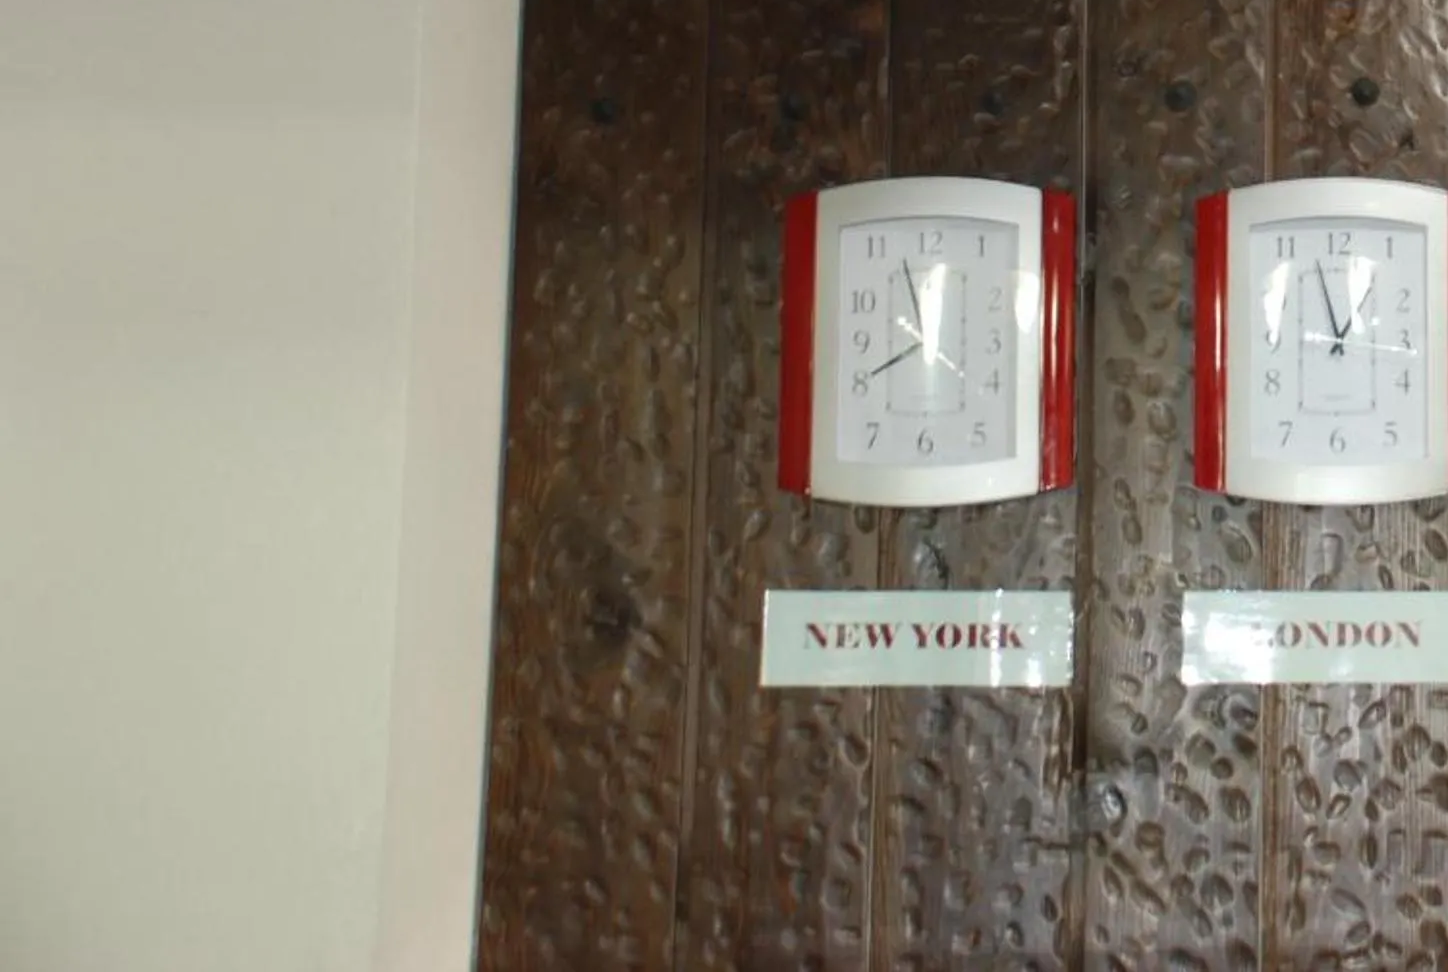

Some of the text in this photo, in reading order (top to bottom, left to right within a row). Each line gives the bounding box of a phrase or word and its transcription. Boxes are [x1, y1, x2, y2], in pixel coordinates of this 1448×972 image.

[866, 235, 887, 259] 11
[918, 231, 943, 255] 12
[976, 235, 986, 258] 1
[1276, 236, 1295, 259] 11
[1327, 232, 1351, 256] 12
[1385, 236, 1394, 259] 1
[851, 290, 876, 314] 10
[988, 289, 1002, 312] 2
[1396, 289, 1411, 313] 2
[852, 330, 870, 354] 9
[986, 330, 1002, 355] 3
[1397, 329, 1412, 355] 3
[852, 371, 869, 396] 8
[985, 371, 999, 394] 4
[1264, 370, 1281, 396] 8
[1395, 370, 1411, 394] 4
[866, 422, 880, 450] 7
[917, 429, 934, 454] 6
[970, 423, 987, 448] 5
[1278, 421, 1294, 448] 7
[1329, 427, 1346, 453] 6
[1382, 421, 1398, 448] 5
[804, 622, 1024, 649] NEW YORK
